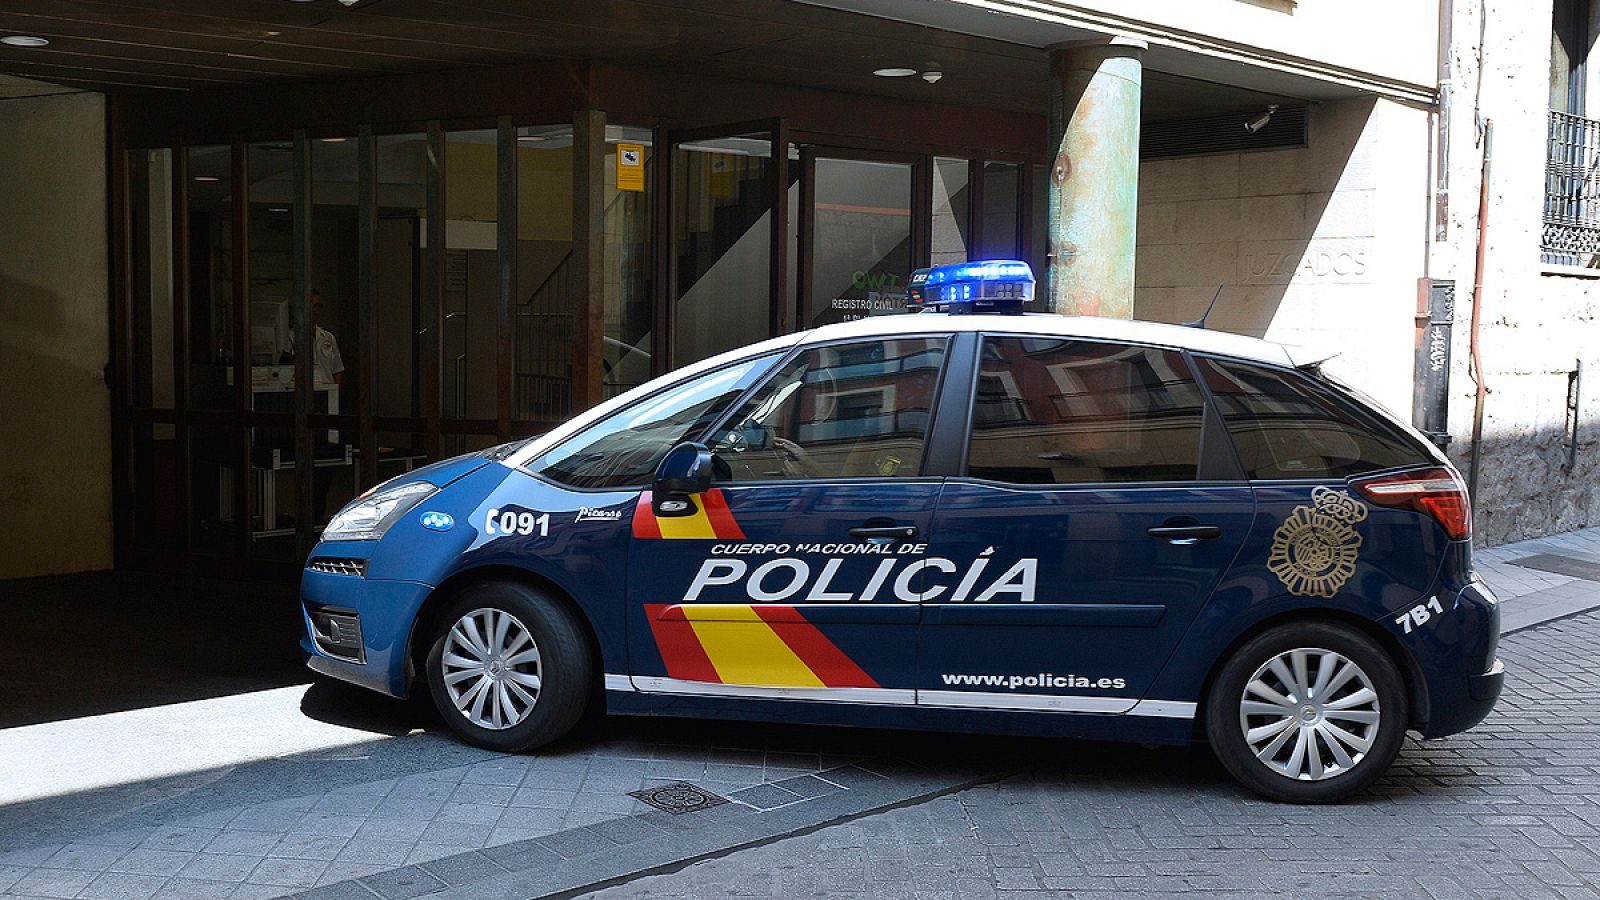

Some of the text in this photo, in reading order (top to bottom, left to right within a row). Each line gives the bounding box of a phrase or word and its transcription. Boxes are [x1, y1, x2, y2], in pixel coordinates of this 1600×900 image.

[831, 298, 872, 310] REGISTRO
[874, 299, 893, 310] CIVIL
[574, 506, 622, 523] Picasso
[500, 511, 550, 537] 091
[711, 543, 928, 554] CUERPO NACIONAL DE
[682, 546, 1039, 602] POLICÍA
[1394, 595, 1444, 634] 7B1
[941, 673, 1126, 689] www.policia.es
